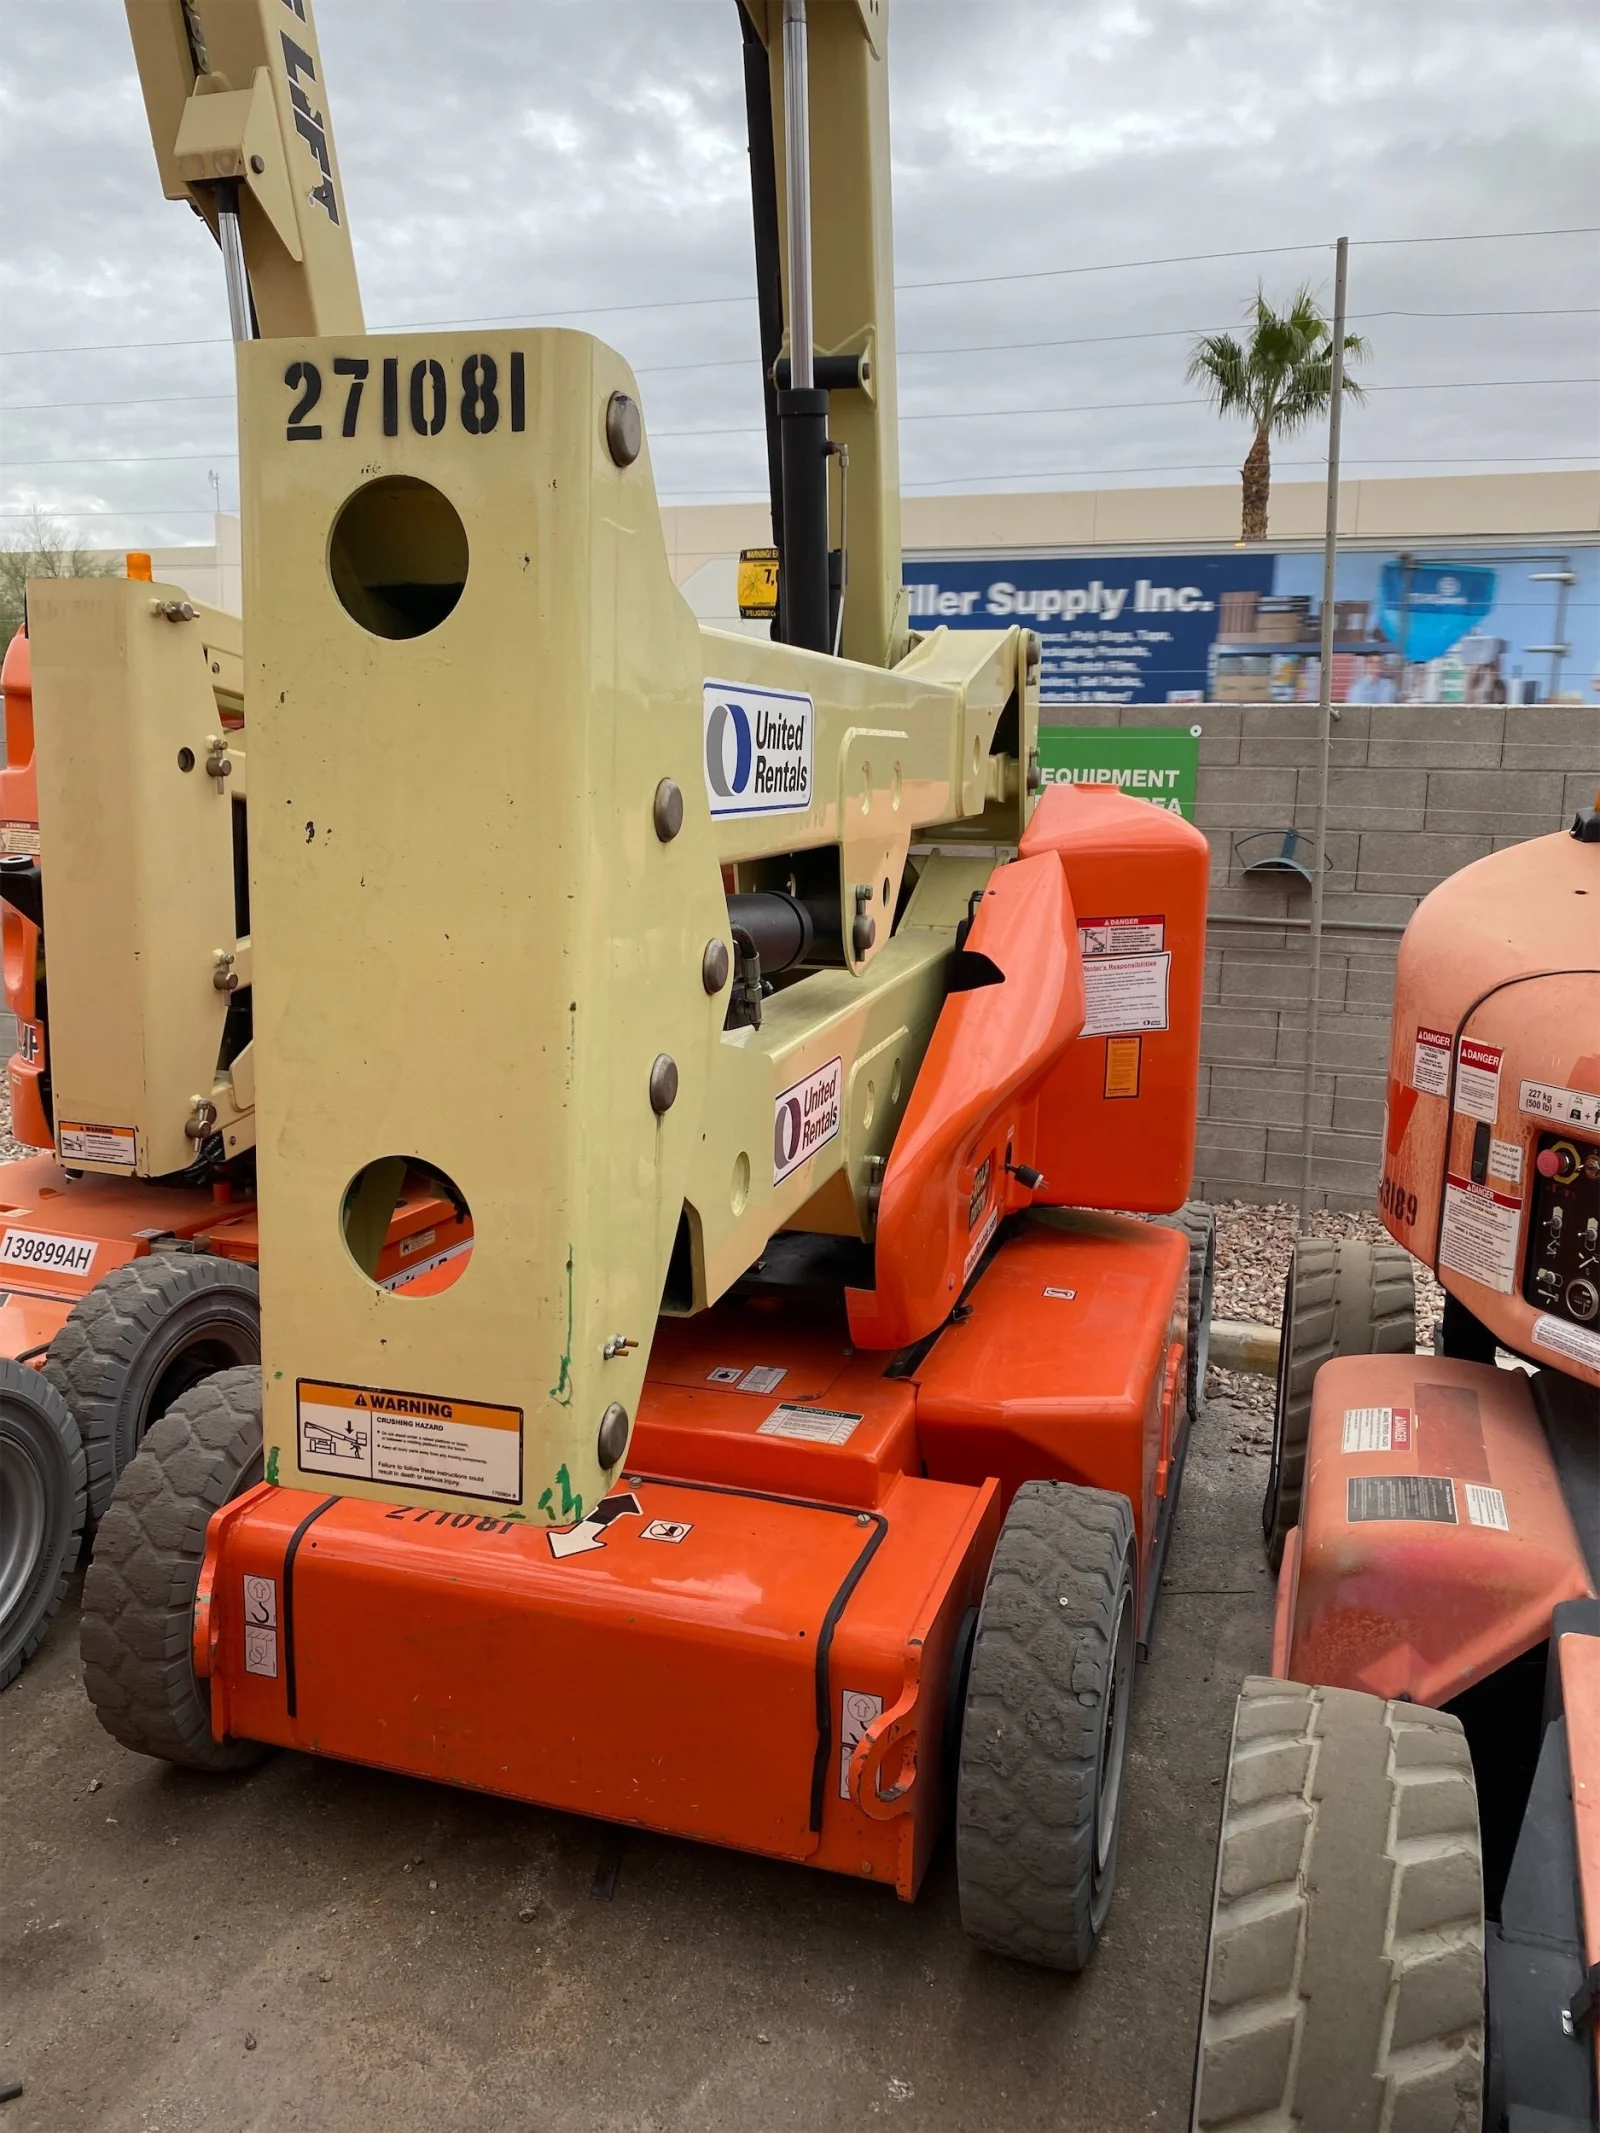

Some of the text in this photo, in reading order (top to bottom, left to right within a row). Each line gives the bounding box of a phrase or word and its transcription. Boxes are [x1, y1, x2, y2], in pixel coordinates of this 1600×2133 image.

[284, 352, 525, 441] 271081
[903, 580, 1215, 621] iller Supply Inc.
[756, 710, 804, 750] United
[755, 756, 807, 793] Rentals
[1041, 768, 1180, 788] EQUIPMENT
[1110, 918, 1139, 926] DANGER
[1108, 960, 1157, 970] Responsibilities
[1423, 1031, 1450, 1047] DANGER
[1467, 1049, 1499, 1066] DANGER
[804, 1070, 837, 1117] United
[1528, 1088, 1552, 1103] 227 kg
[1525, 1098, 1552, 1114] (500 lb)
[802, 1101, 837, 1151] Rentals
[1472, 1184, 1494, 1200] DANGER
[1380, 1178, 1417, 1226] 3189
[3, 1236, 91, 1270] 139899AH
[370, 1395, 453, 1418] WARNING
[795, 1406, 845, 1418] IMPORTANT
[376, 1416, 444, 1432] CRUSHING HAZARD
[1395, 1420, 1406, 1442] DANGER
[378, 1461, 395, 1469] Failure
[436, 1469, 467, 1480] instructions
[423, 1475, 443, 1483] serious
